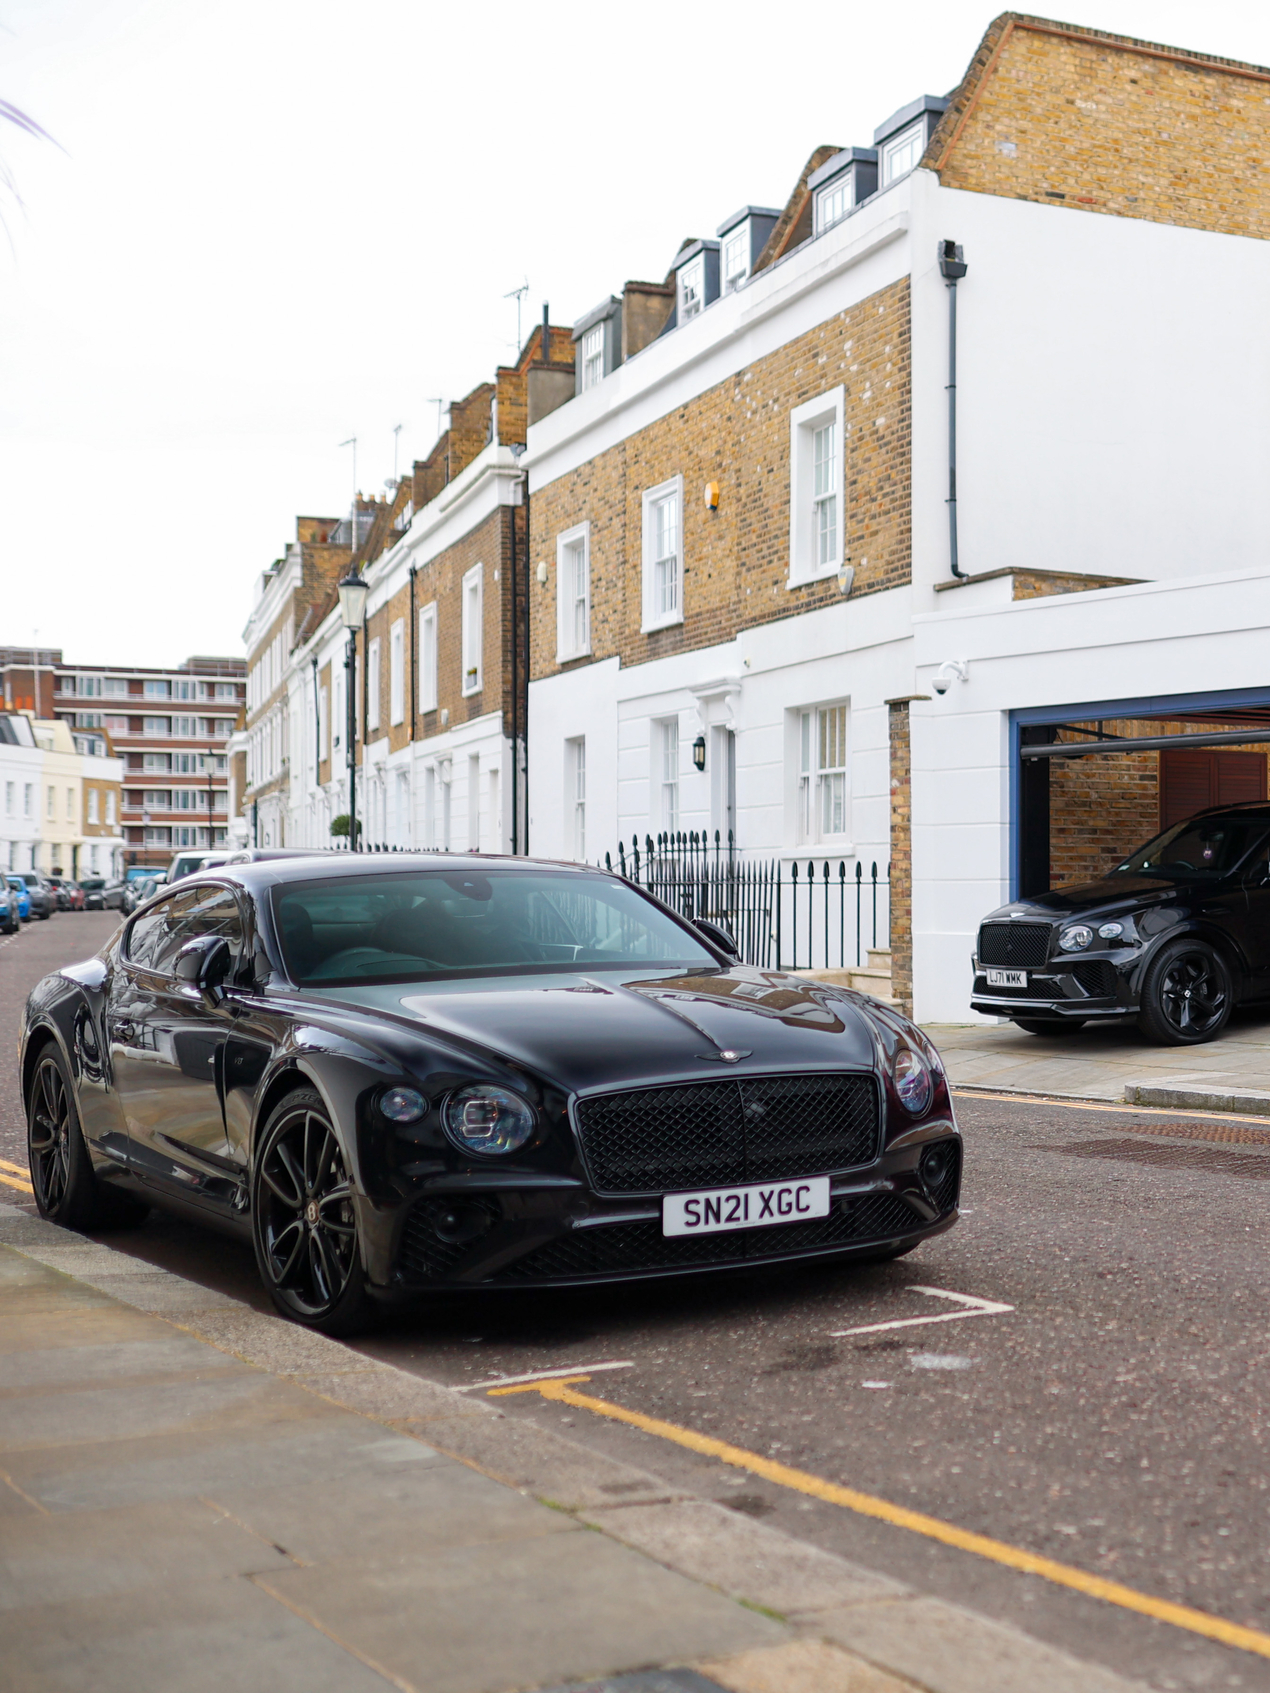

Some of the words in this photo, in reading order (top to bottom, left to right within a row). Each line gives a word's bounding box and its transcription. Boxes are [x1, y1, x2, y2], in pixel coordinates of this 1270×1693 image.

[990, 971, 1005, 983] LJ71
[1005, 972, 1022, 984] WMK
[684, 1193, 749, 1228] SN21
[758, 1185, 811, 1219] XGC
